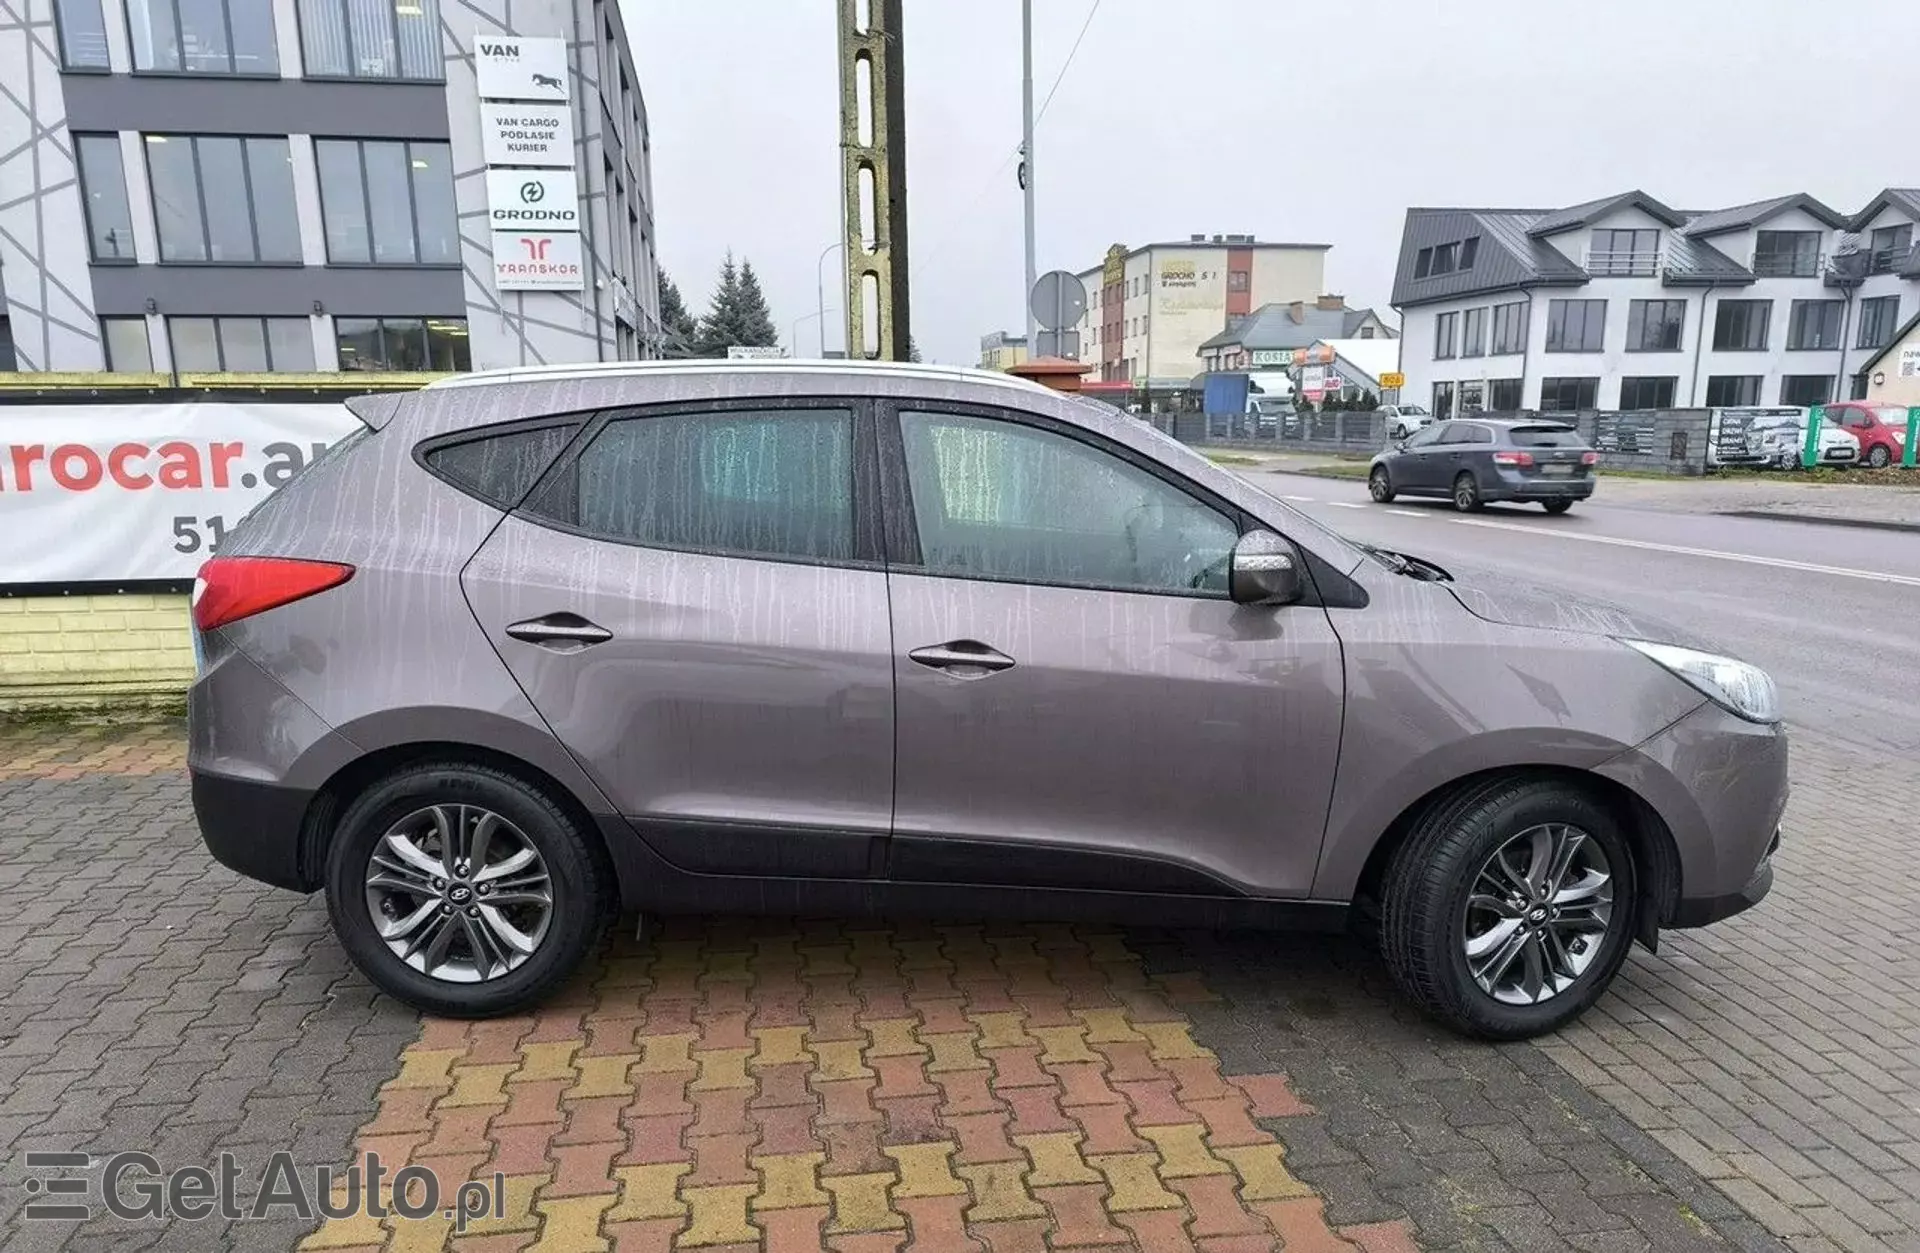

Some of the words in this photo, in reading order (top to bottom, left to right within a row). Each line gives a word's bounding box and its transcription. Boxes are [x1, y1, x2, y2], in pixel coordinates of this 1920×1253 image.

[480, 44, 520, 57] VAN
[496, 118, 518, 126] VAN
[521, 118, 559, 127] CARGO
[500, 131, 556, 140] PODLASIE
[507, 143, 548, 152] KURIER
[493, 209, 576, 221] GRODNO
[496, 264, 578, 274] TRANSKOR
